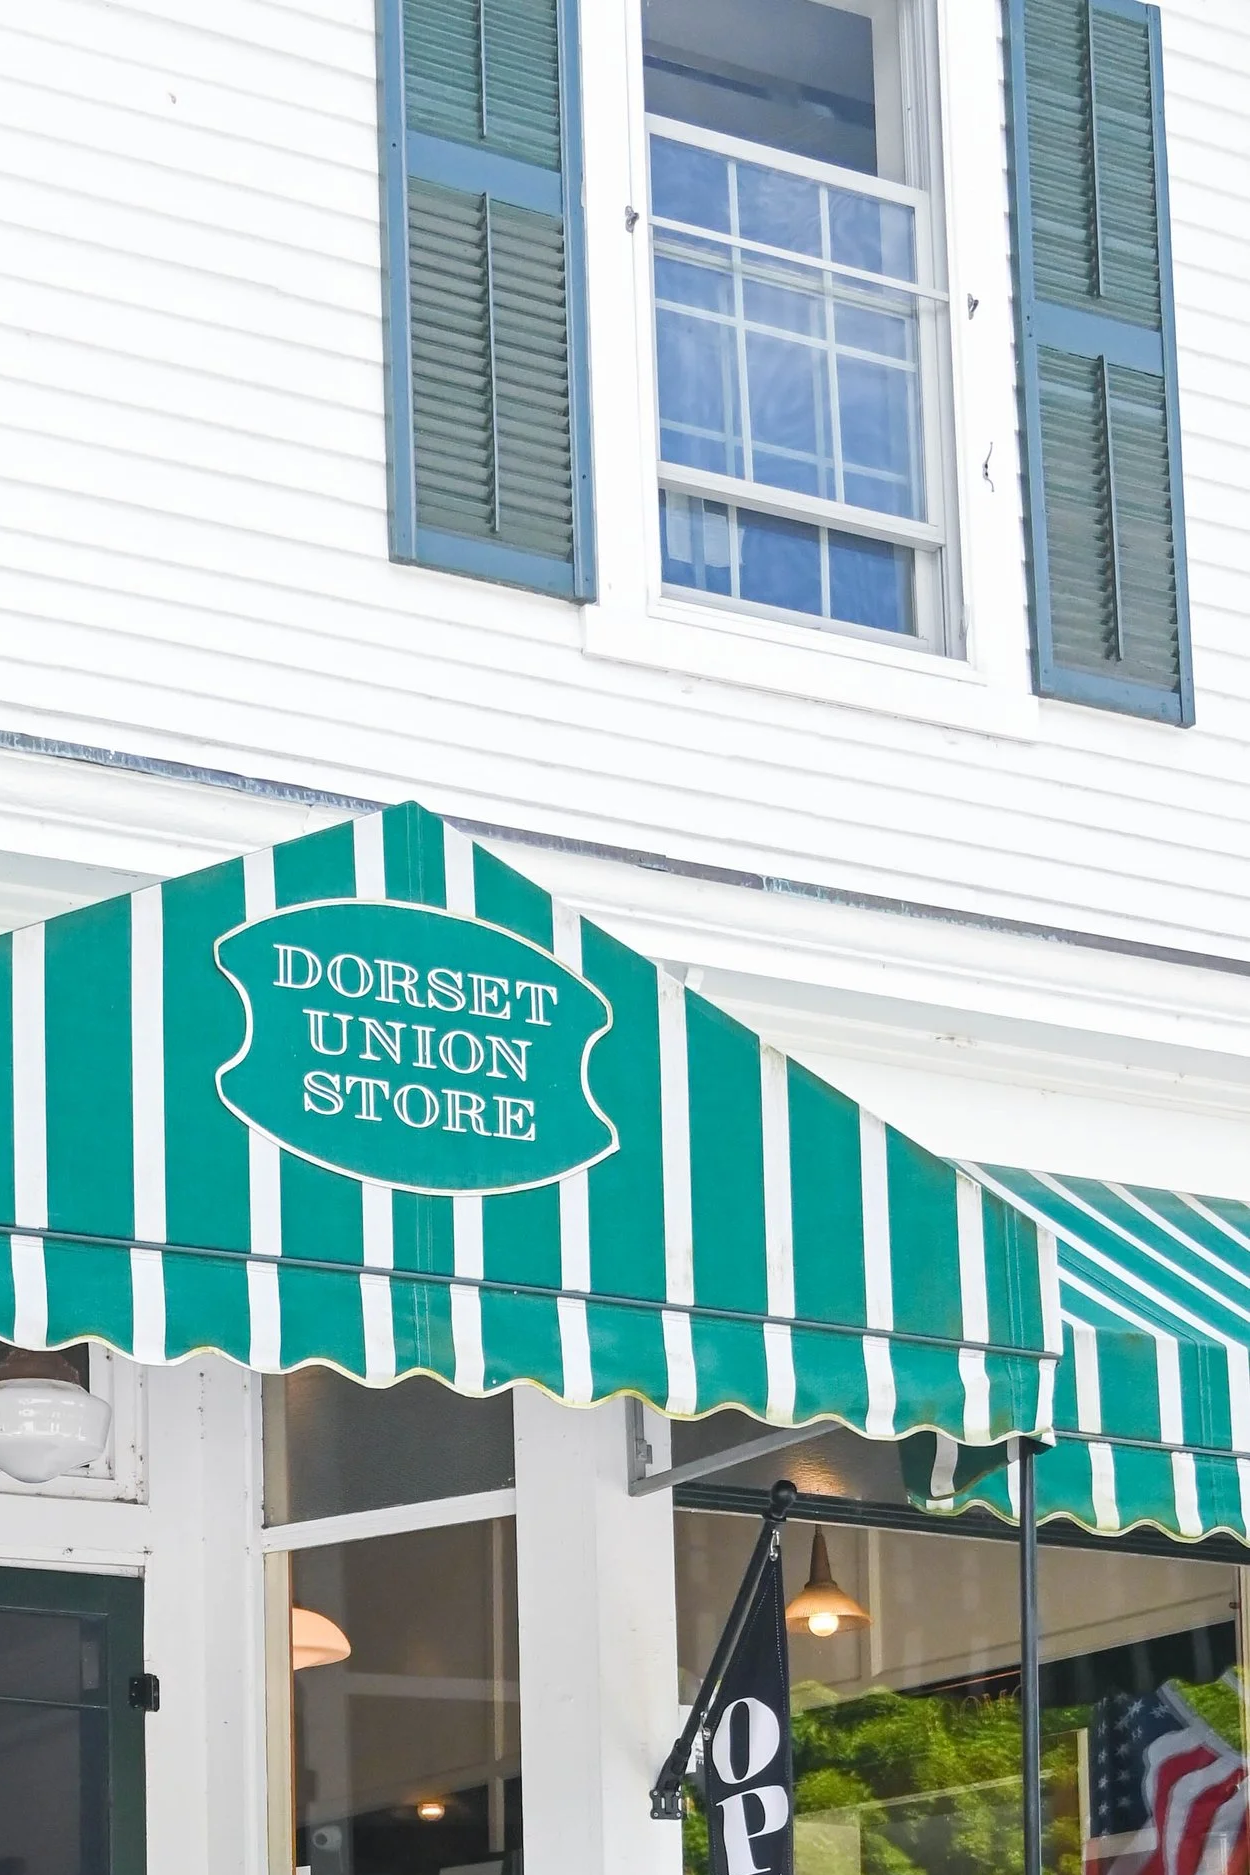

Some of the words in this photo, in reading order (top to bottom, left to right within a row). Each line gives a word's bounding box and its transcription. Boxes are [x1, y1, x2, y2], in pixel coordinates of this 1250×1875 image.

[272, 943, 559, 1027] DORSET
[302, 1008, 533, 1082] UNION
[302, 1070, 536, 1142] STORE
